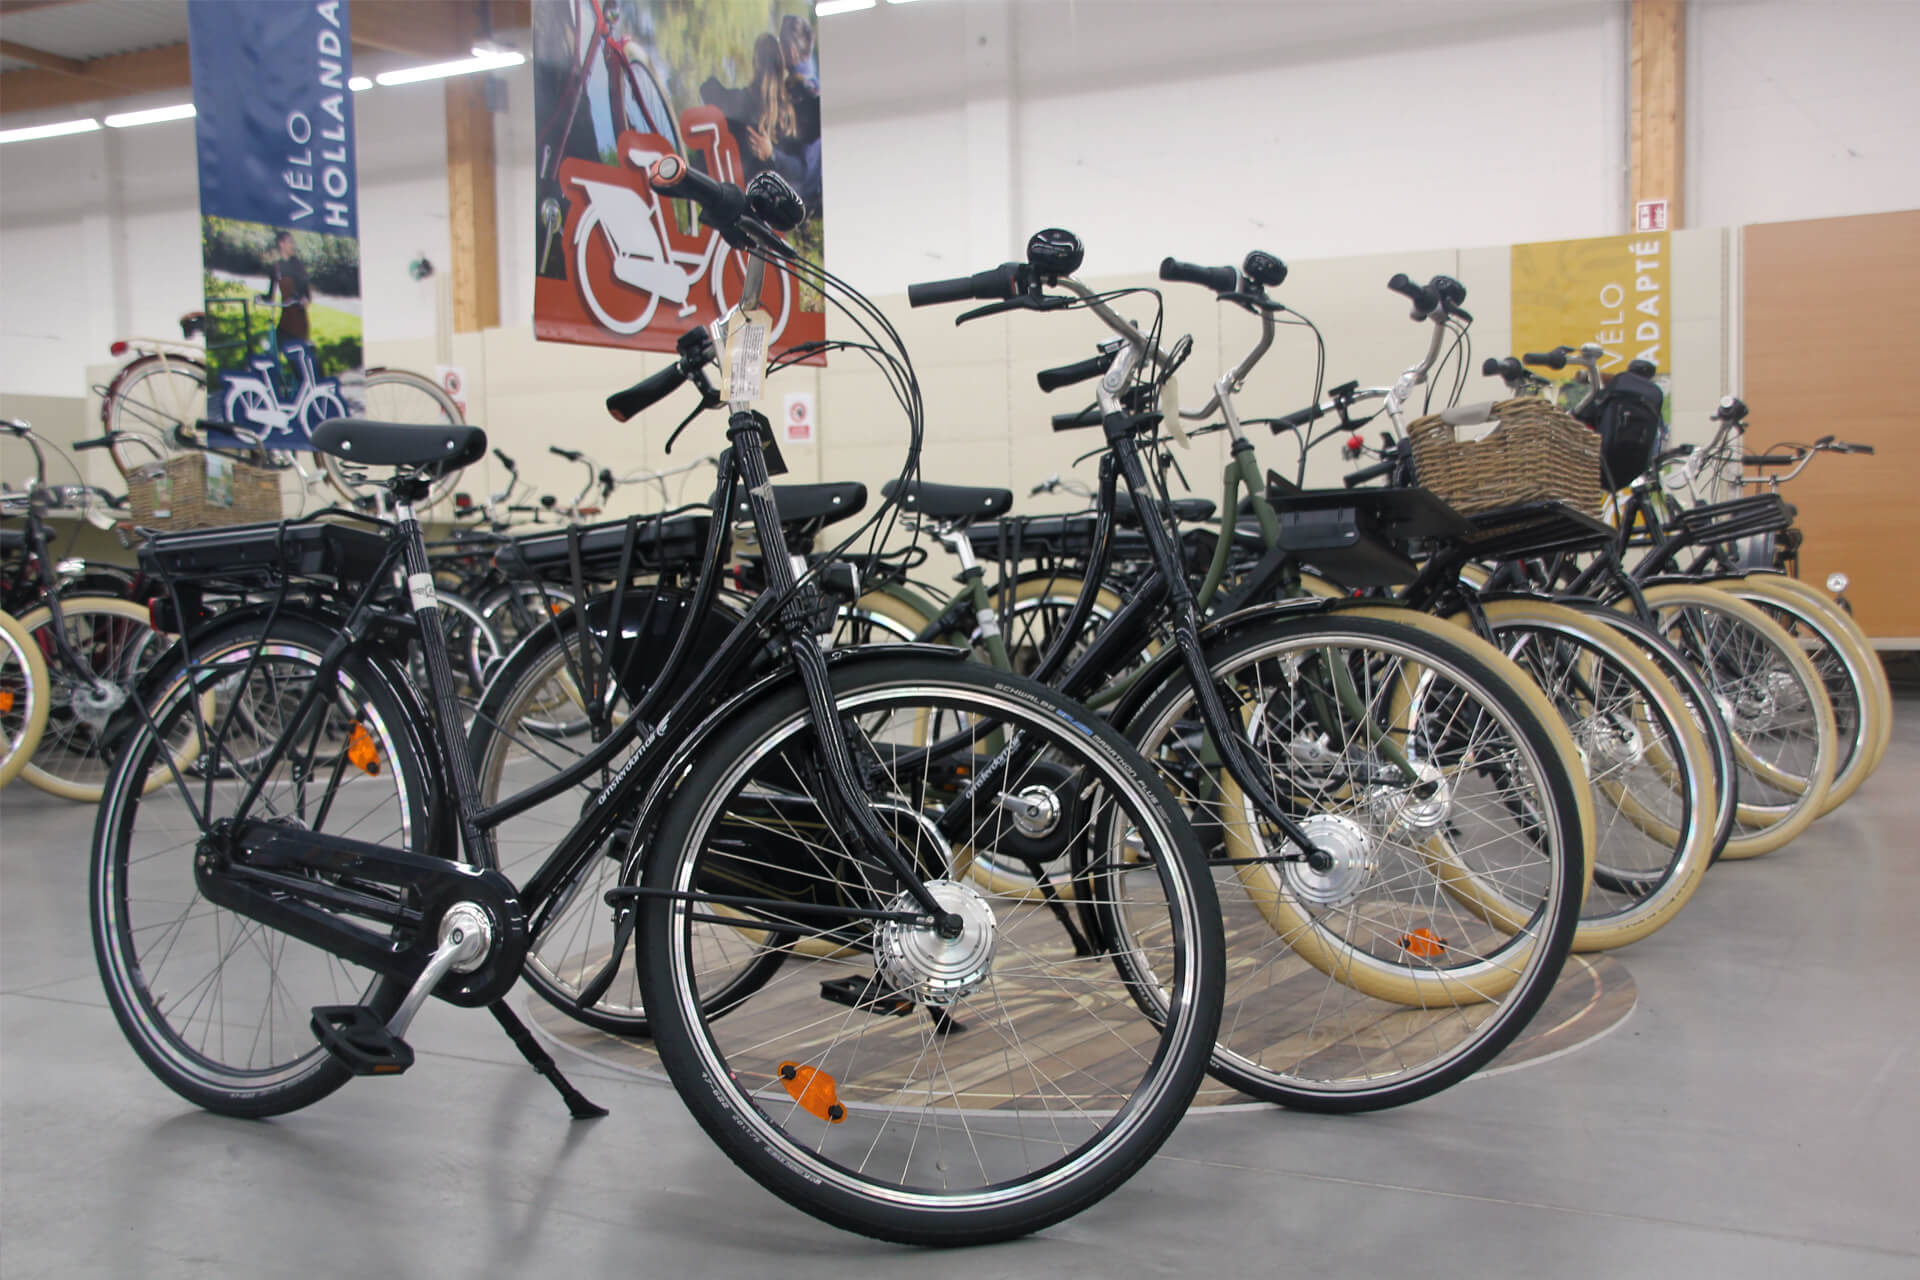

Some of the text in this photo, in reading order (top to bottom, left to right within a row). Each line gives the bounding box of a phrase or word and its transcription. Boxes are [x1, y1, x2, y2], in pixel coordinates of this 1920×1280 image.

[282, 110, 314, 221] VÉLO
[1596, 283, 1624, 370] VÉLO
[1629, 240, 1660, 366] ADAPTÉ
[598, 745, 646, 805] amsterdam
[994, 683, 1159, 805] SCHWALBE MARATHON PLUS
[701, 1071, 729, 1109] 47-622
